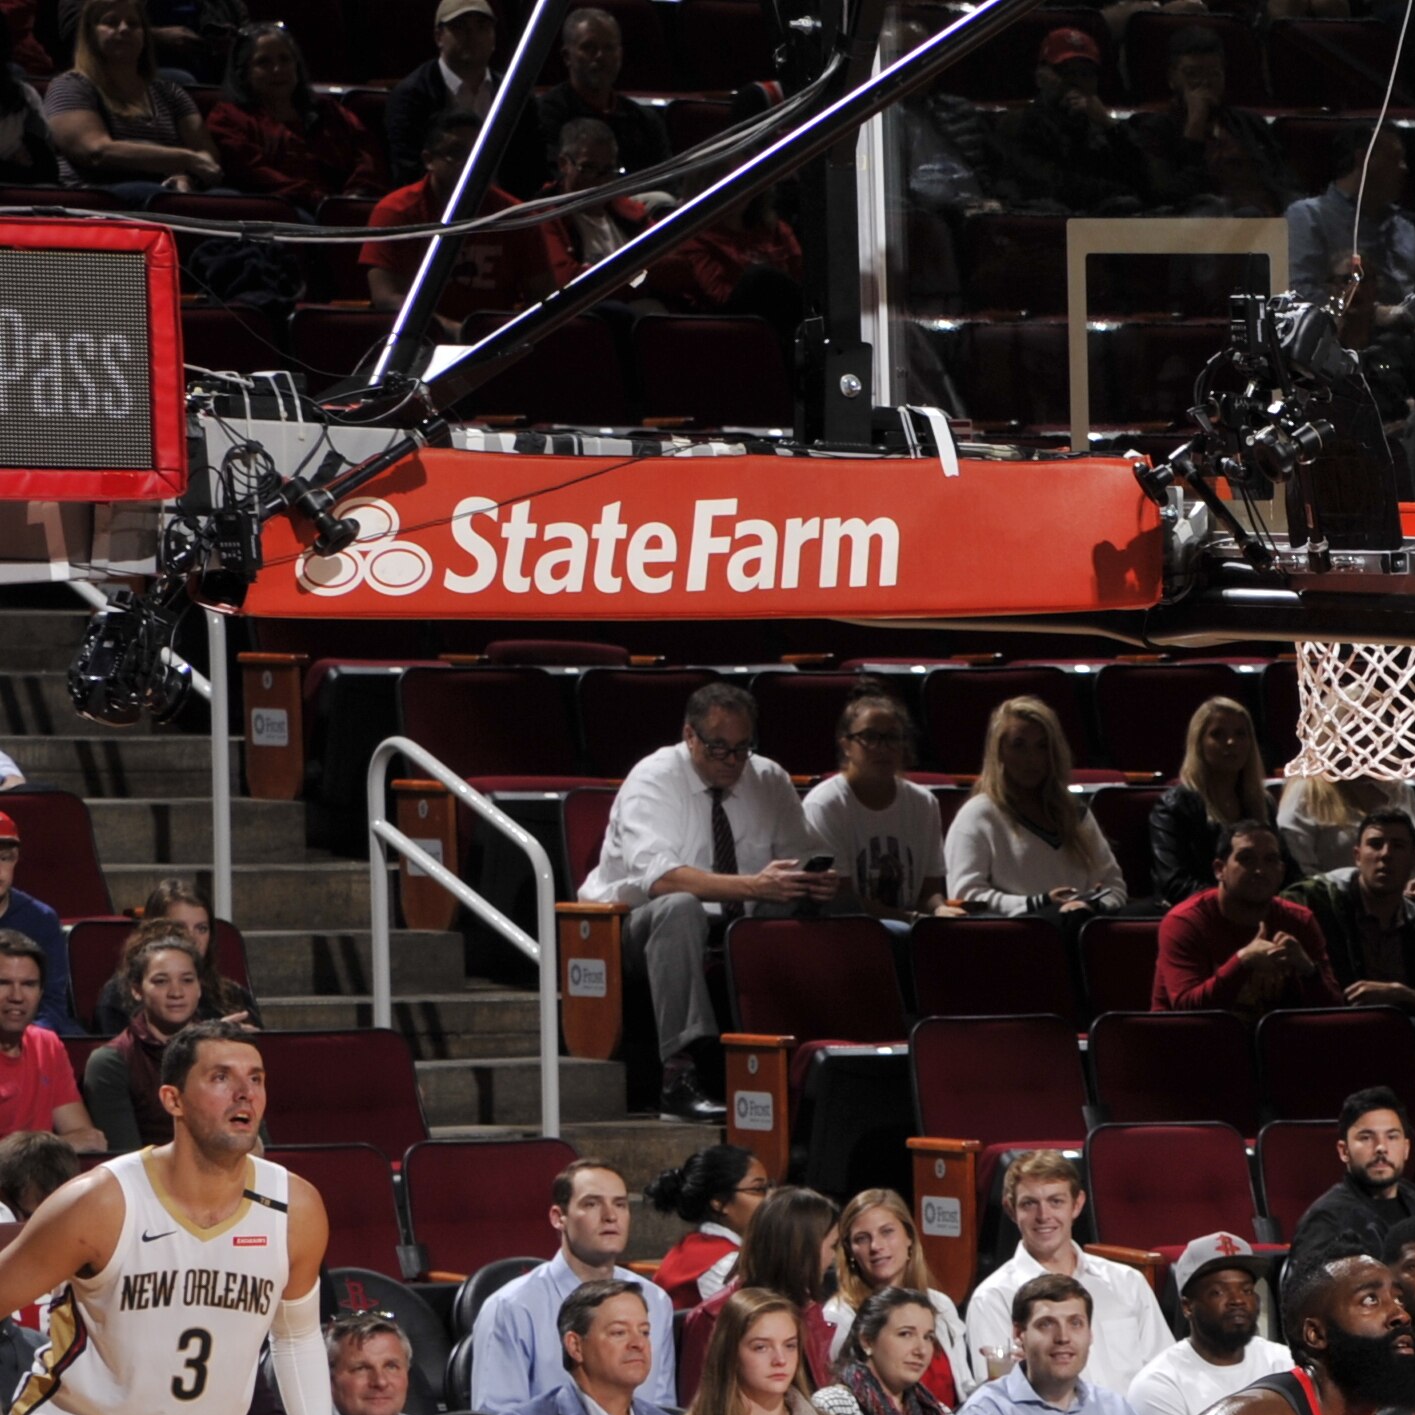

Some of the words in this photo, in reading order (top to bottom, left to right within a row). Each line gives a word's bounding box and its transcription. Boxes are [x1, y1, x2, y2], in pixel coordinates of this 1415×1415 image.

[0, 308, 134, 420] Pass
[443, 496, 677, 595] State
[686, 497, 900, 593] Farm
[266, 717, 287, 733] Frost
[583, 968, 604, 984] Frost
[750, 1101, 771, 1117] Frost
[937, 1206, 959, 1224] Frost
[120, 1270, 179, 1311] NEW
[183, 1269, 274, 1315] ORLEANS
[170, 1326, 213, 1402] 3
